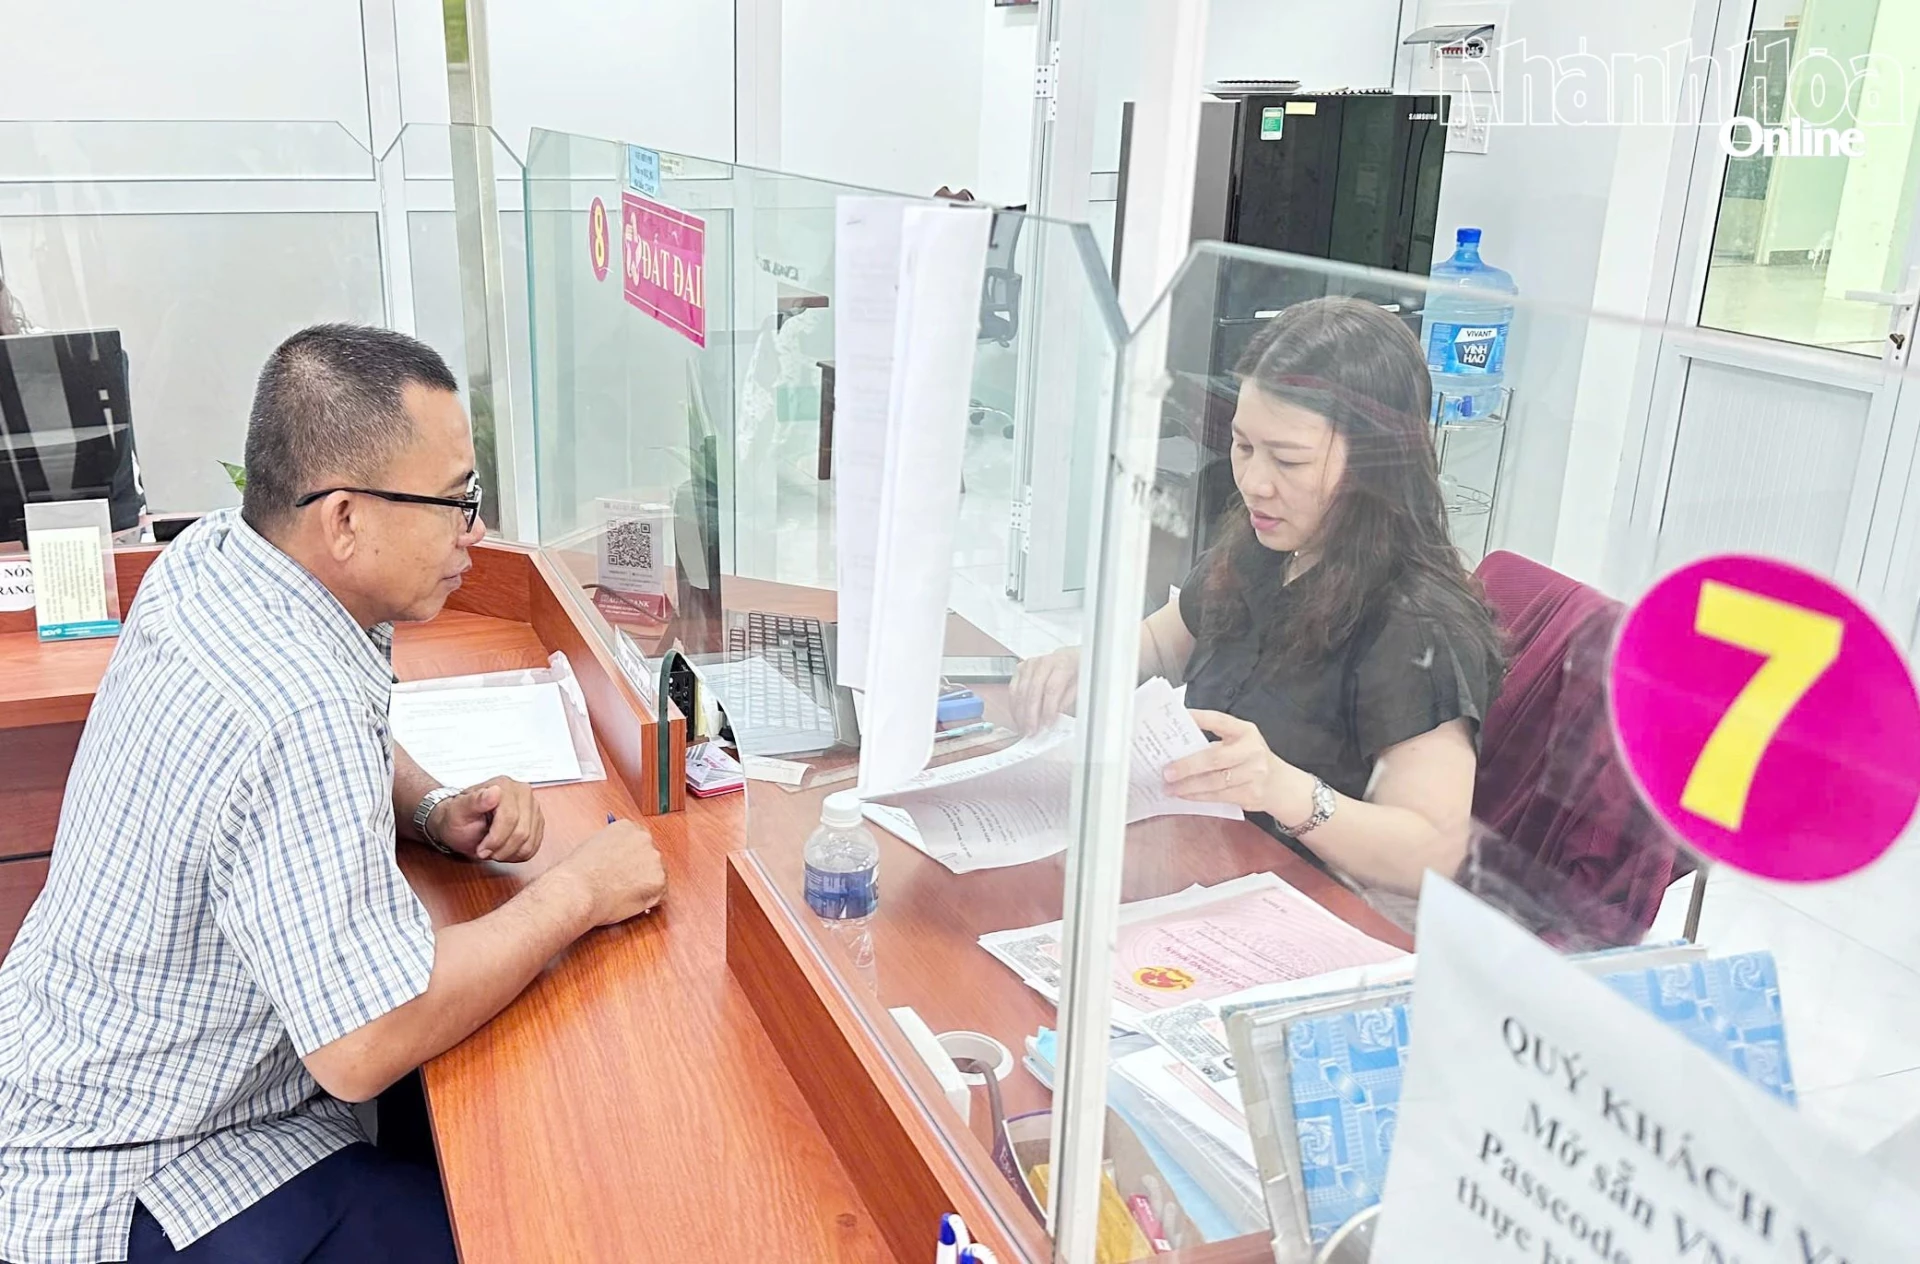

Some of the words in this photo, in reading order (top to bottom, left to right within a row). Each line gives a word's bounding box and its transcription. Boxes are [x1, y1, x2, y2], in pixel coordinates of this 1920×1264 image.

[594, 205, 605, 267] 8
[1466, 330, 1493, 338] VIVANT
[1679, 577, 1844, 832] 7
[1502, 1016, 1589, 1094] QUÝ
[1600, 1086, 1772, 1239] KHÁCH
[1522, 1099, 1588, 1167] Mở
[1590, 1157, 1655, 1229] sẵn
[1457, 1175, 1532, 1251] thực
